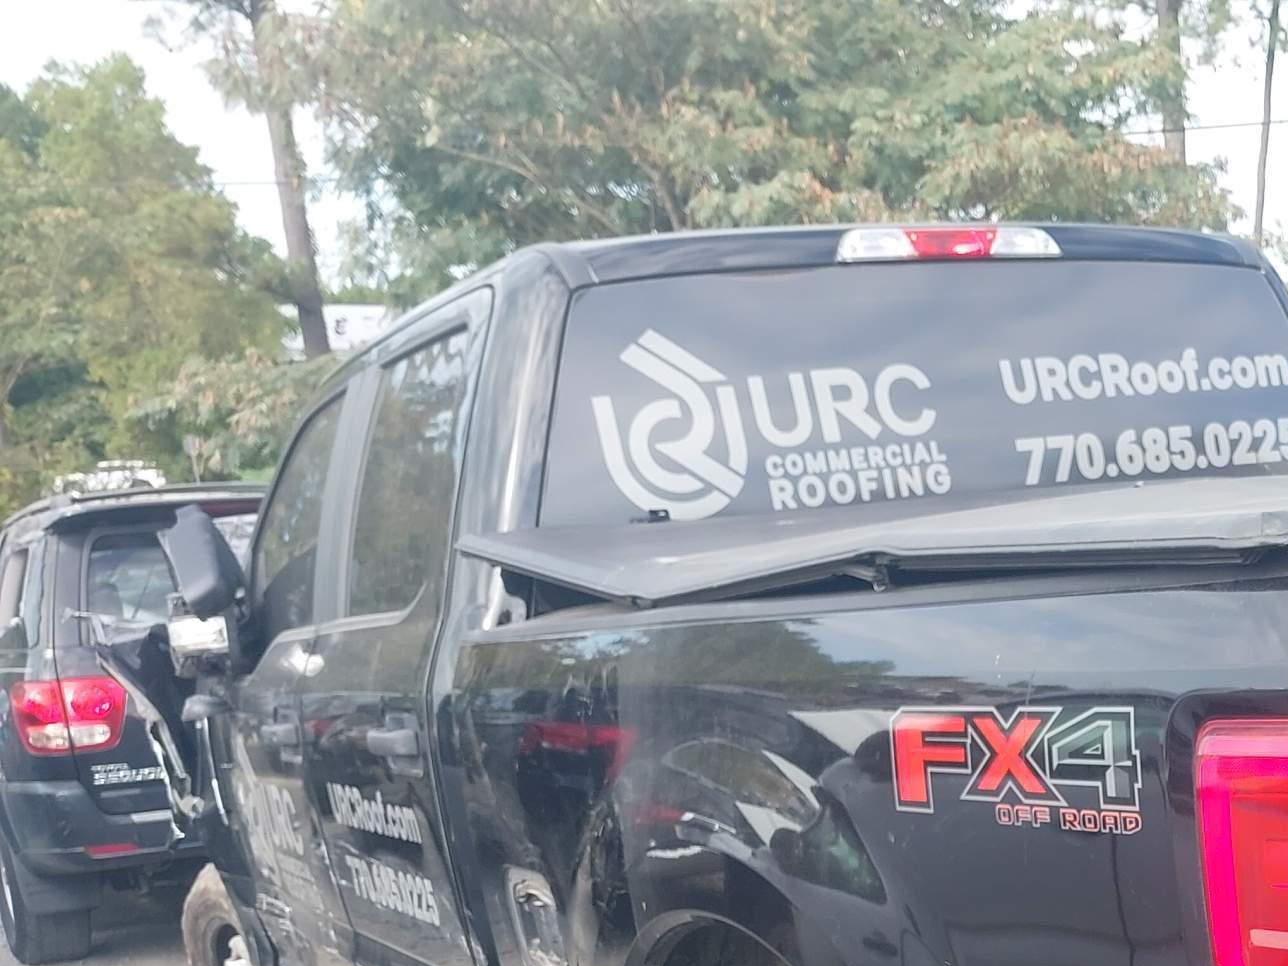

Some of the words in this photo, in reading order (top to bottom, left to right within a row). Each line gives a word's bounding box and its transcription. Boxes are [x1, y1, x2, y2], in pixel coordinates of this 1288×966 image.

[746, 363, 937, 448] URC
[764, 440, 948, 478] COMMERCIAL
[767, 464, 952, 512] ROOFING
[889, 705, 1143, 814] FX4
[995, 803, 1051, 828] OFF
[1059, 808, 1143, 835] ROAD
